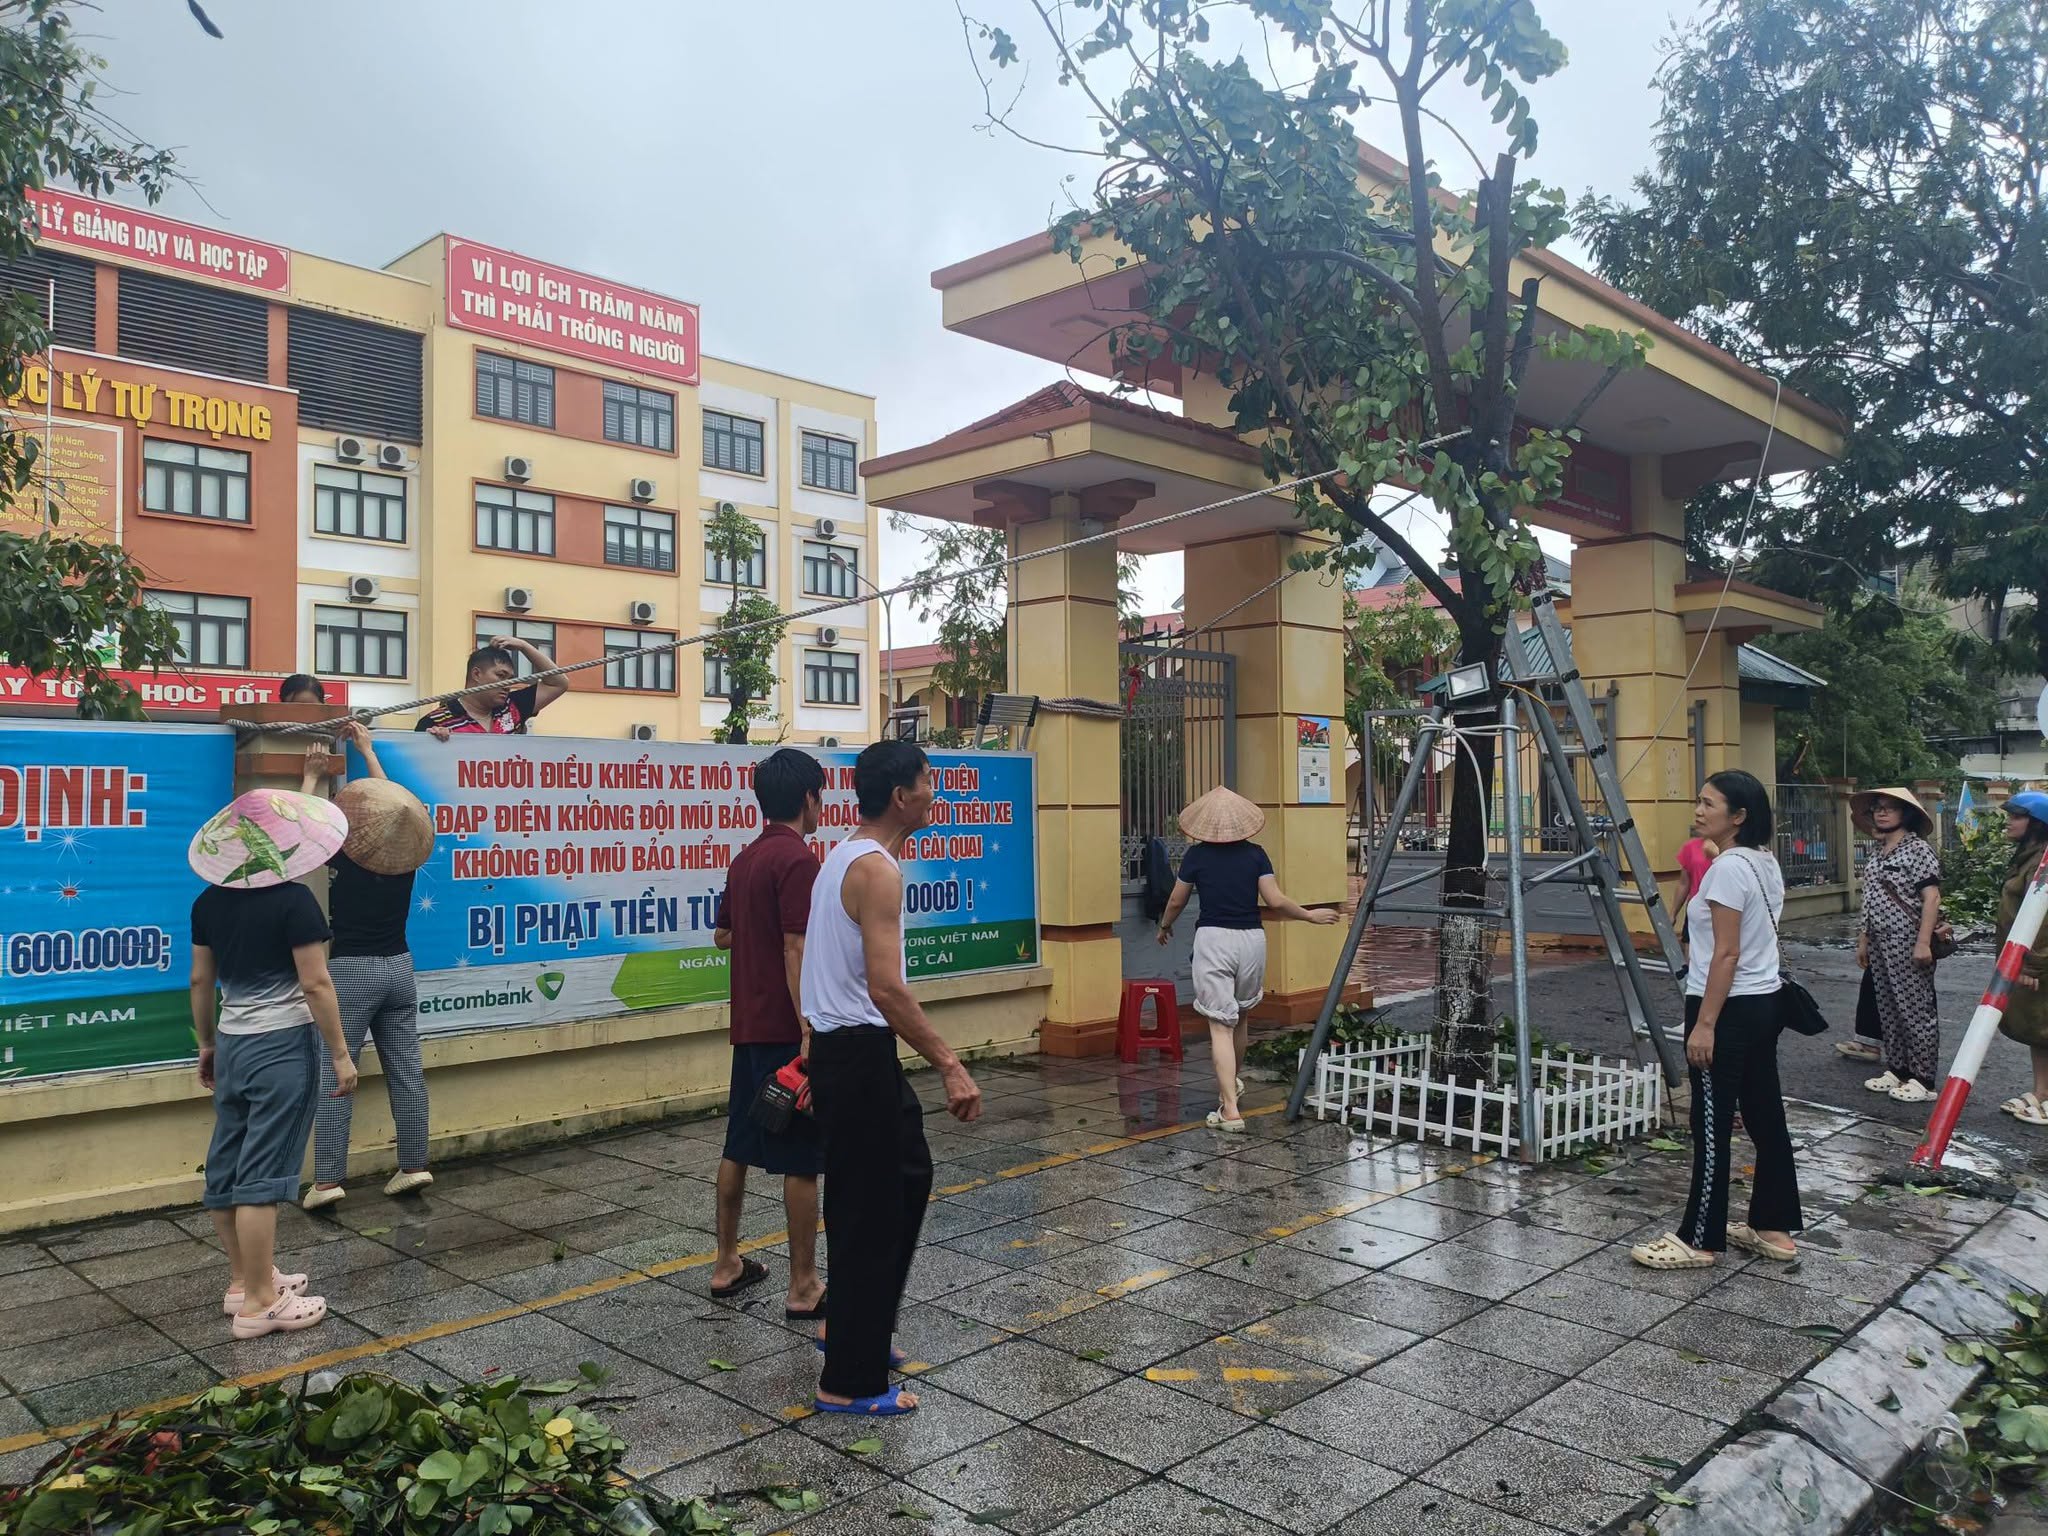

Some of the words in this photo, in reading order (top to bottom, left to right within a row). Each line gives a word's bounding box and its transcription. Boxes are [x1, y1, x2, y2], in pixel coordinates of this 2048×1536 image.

[42, 202, 68, 235] LÝ,
[73, 208, 129, 246] GIẢNG
[135, 226, 169, 257] DẠY
[173, 234, 195, 263] VÀ
[200, 242, 233, 273] HỌC
[237, 249, 268, 281] TẬP
[471, 257, 493, 284] VÌ
[500, 265, 531, 296] LỢI
[538, 272, 571, 305] ÍCH
[578, 287, 633, 322] TRĂM
[639, 305, 684, 336] NĂM
[461, 289, 496, 318] THÌ
[503, 302, 552, 333] PHẢI
[559, 314, 624, 351] TRỒNG
[629, 333, 685, 366] NGƯỜI
[63, 367, 103, 412] LÝ
[111, 380, 157, 428] TỰ
[165, 389, 272, 442] TRỌNG
[141, 684, 206, 707] HỌC
[216, 683, 272, 705] TỐT
[458, 754, 534, 788] NGƯỜI
[540, 754, 592, 789] ĐIỀU
[600, 753, 664, 789] KHIỂN
[669, 765, 695, 790] XE
[701, 761, 732, 790] MÔ
[943, 763, 979, 795] ĐIỆN
[436, 805, 488, 840] ĐẠP
[494, 799, 551, 838] ĐIỆN
[558, 800, 634, 832] KHÔNG
[639, 799, 675, 835] ĐỘI
[681, 800, 713, 831] MŨ
[718, 797, 757, 830] BẢO
[953, 796, 991, 825] TRÊN
[993, 801, 1013, 825] XE
[453, 844, 539, 879] KHÔNG
[546, 843, 584, 880] ĐỘI
[590, 842, 627, 872] MŨ
[632, 837, 674, 872] BẢO
[680, 834, 731, 870] HIỂM
[920, 832, 946, 860] CÀI
[949, 836, 983, 861] QUAI
[468, 906, 504, 954] BỊ
[516, 901, 601, 949] PHẠT
[611, 886, 677, 937] TIỀN
[687, 888, 723, 930] TỪ
[680, 955, 727, 970] NGÂN
[940, 931, 968, 944] VIỆT
[972, 930, 999, 941] NAM
[926, 950, 953, 965] CÁI
[67, 1008, 136, 1026] NAM
[419, 986, 534, 1014] etcombank
